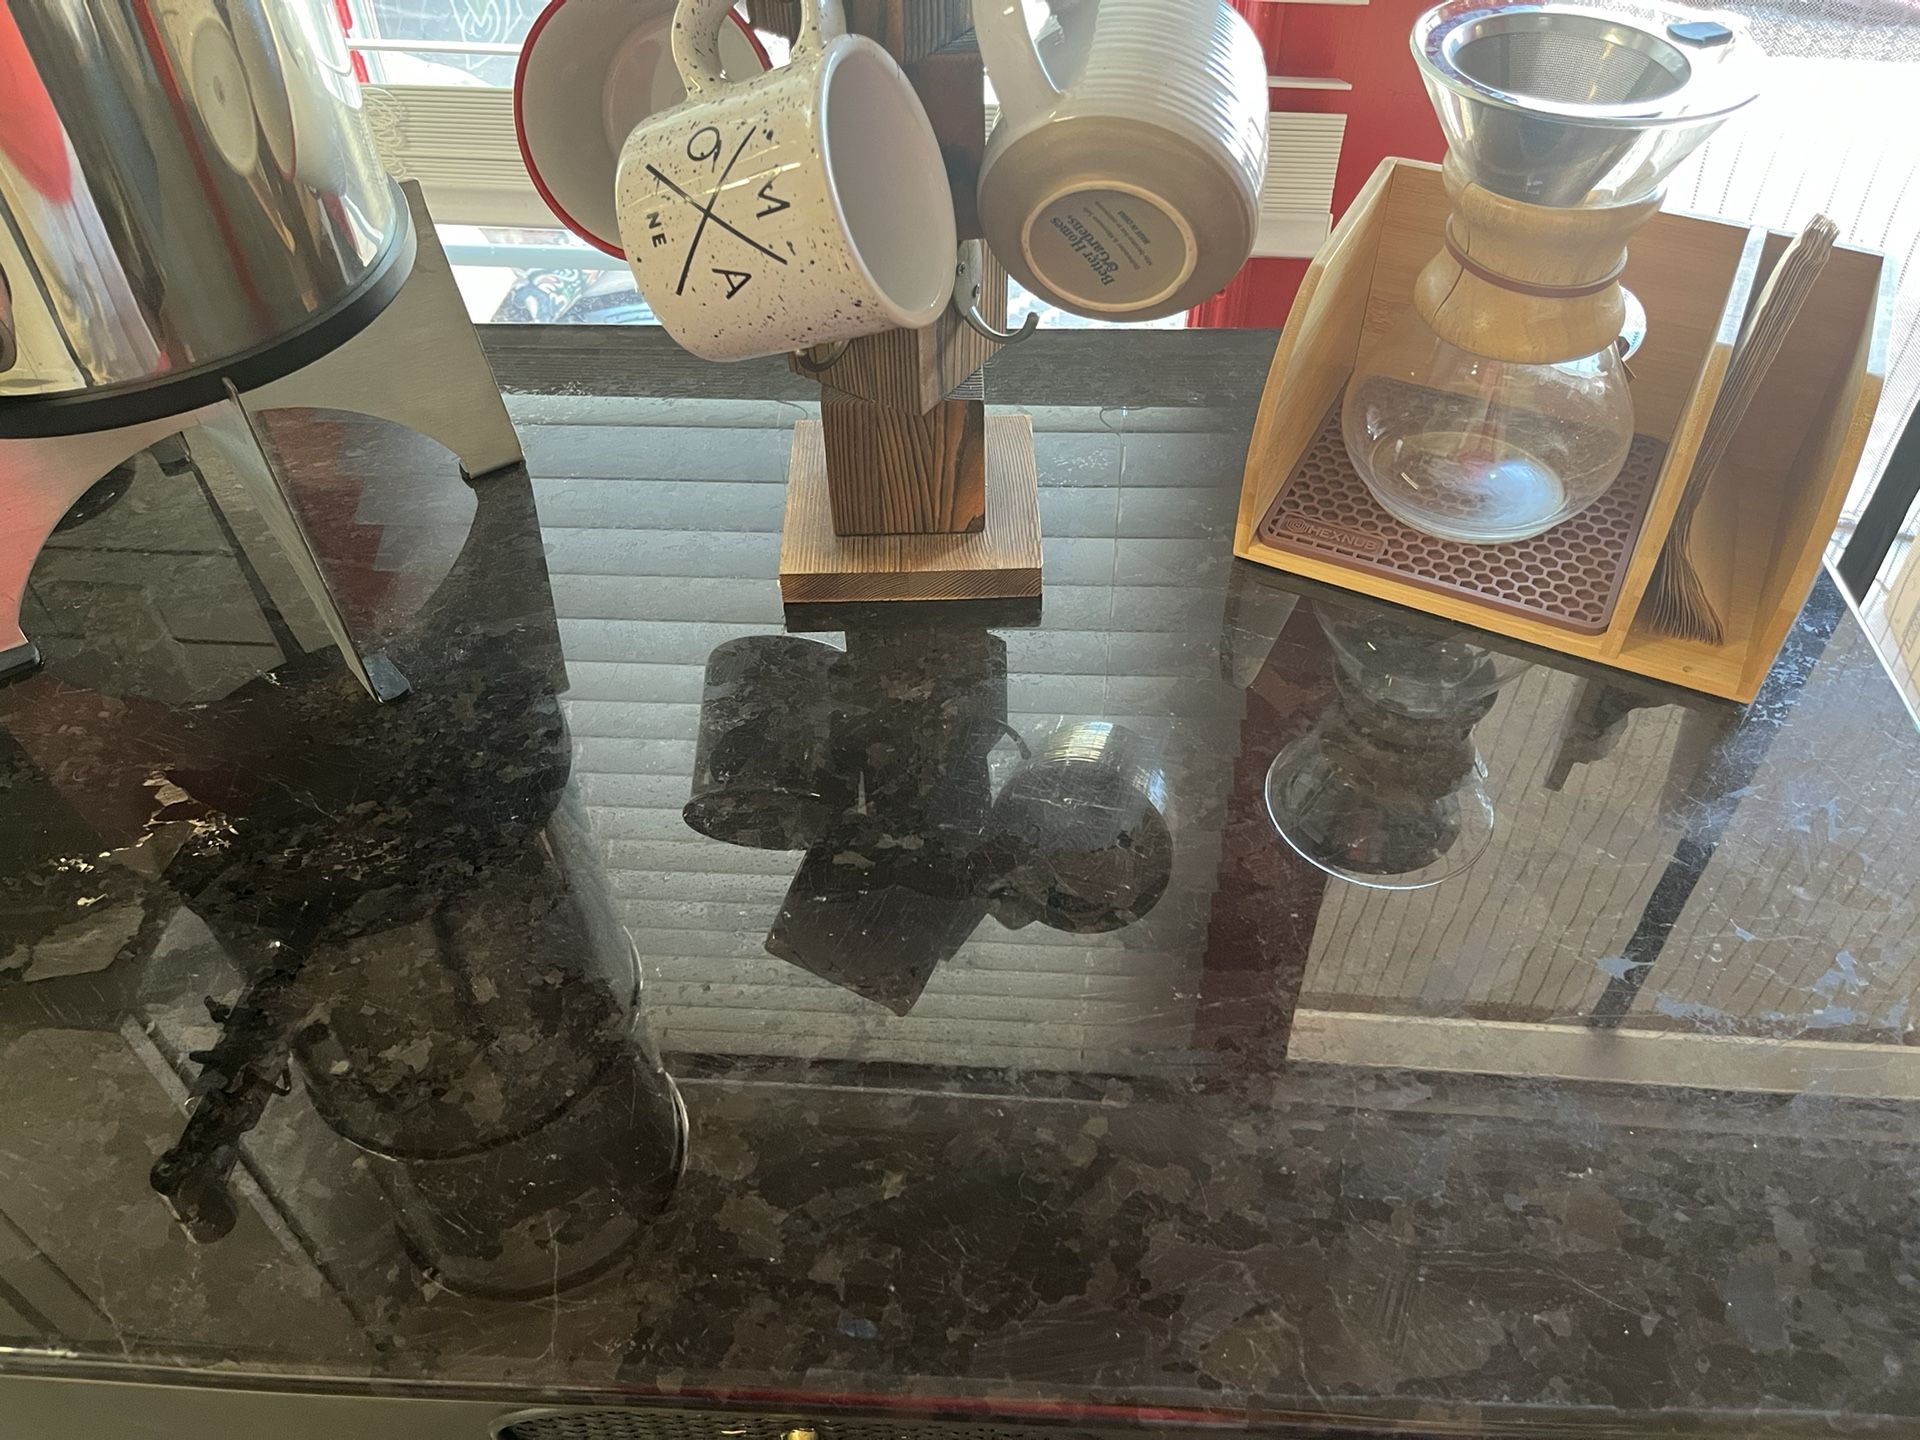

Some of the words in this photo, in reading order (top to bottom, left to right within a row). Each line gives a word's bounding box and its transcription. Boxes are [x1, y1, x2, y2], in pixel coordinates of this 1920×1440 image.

[646, 211, 667, 248] NE
[1051, 217, 1086, 253] Homes
[711, 268, 752, 300] A
[1083, 251, 1115, 286] Better
[1306, 524, 1378, 550] HEXNUB
